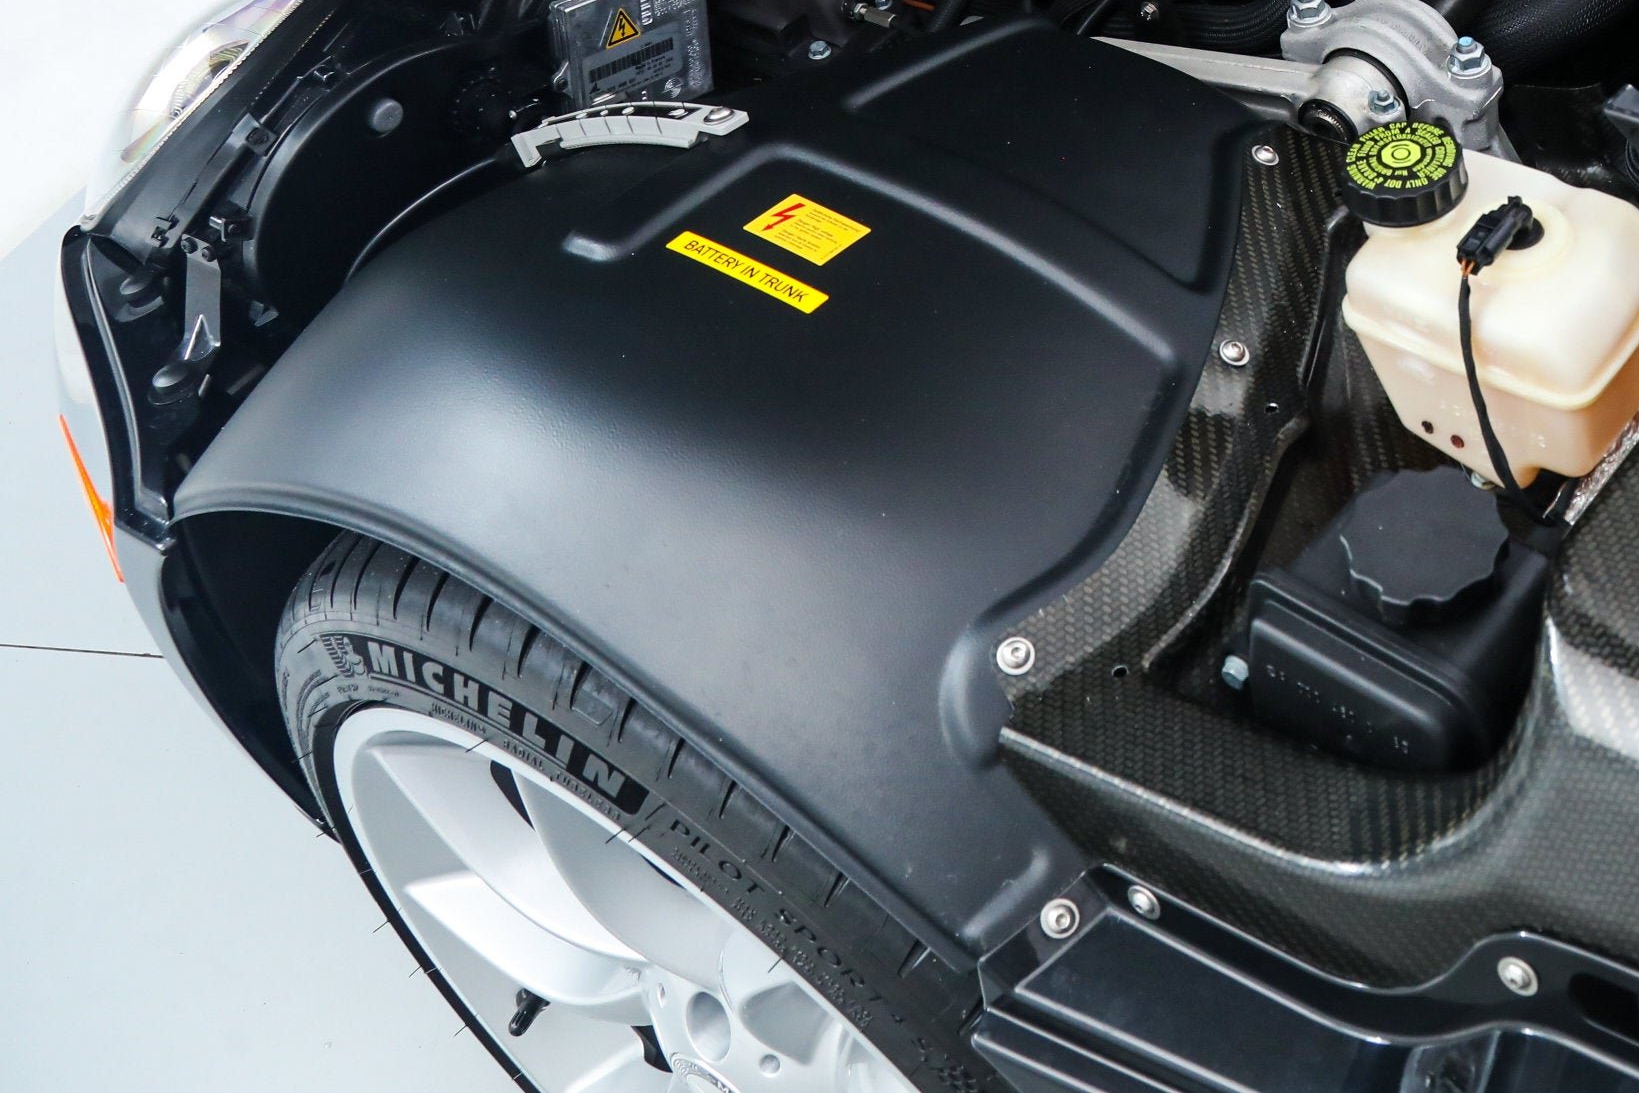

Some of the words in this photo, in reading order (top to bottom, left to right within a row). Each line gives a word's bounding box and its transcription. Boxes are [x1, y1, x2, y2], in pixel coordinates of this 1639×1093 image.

[1359, 127, 1386, 142] FILLER
[1374, 128, 1401, 140] FROM
[1412, 122, 1444, 136] BEFORE
[1415, 129, 1441, 145] SEALED
[1346, 144, 1361, 163] CLEAN
[1357, 140, 1374, 157] FLUID
[1347, 164, 1376, 190] WARNING
[1356, 159, 1377, 180] BRAKE
[1429, 167, 1447, 181] USE
[1384, 179, 1401, 188] DOT
[1406, 177, 1429, 188] ONLY
[684, 240, 743, 269] BATTERY
[741, 265, 760, 278] IN
[758, 273, 809, 303] TRUNK
[367, 641, 626, 798] MICHELIN
[669, 819, 766, 894] PILOT
[775, 908, 883, 1002] SPORT
